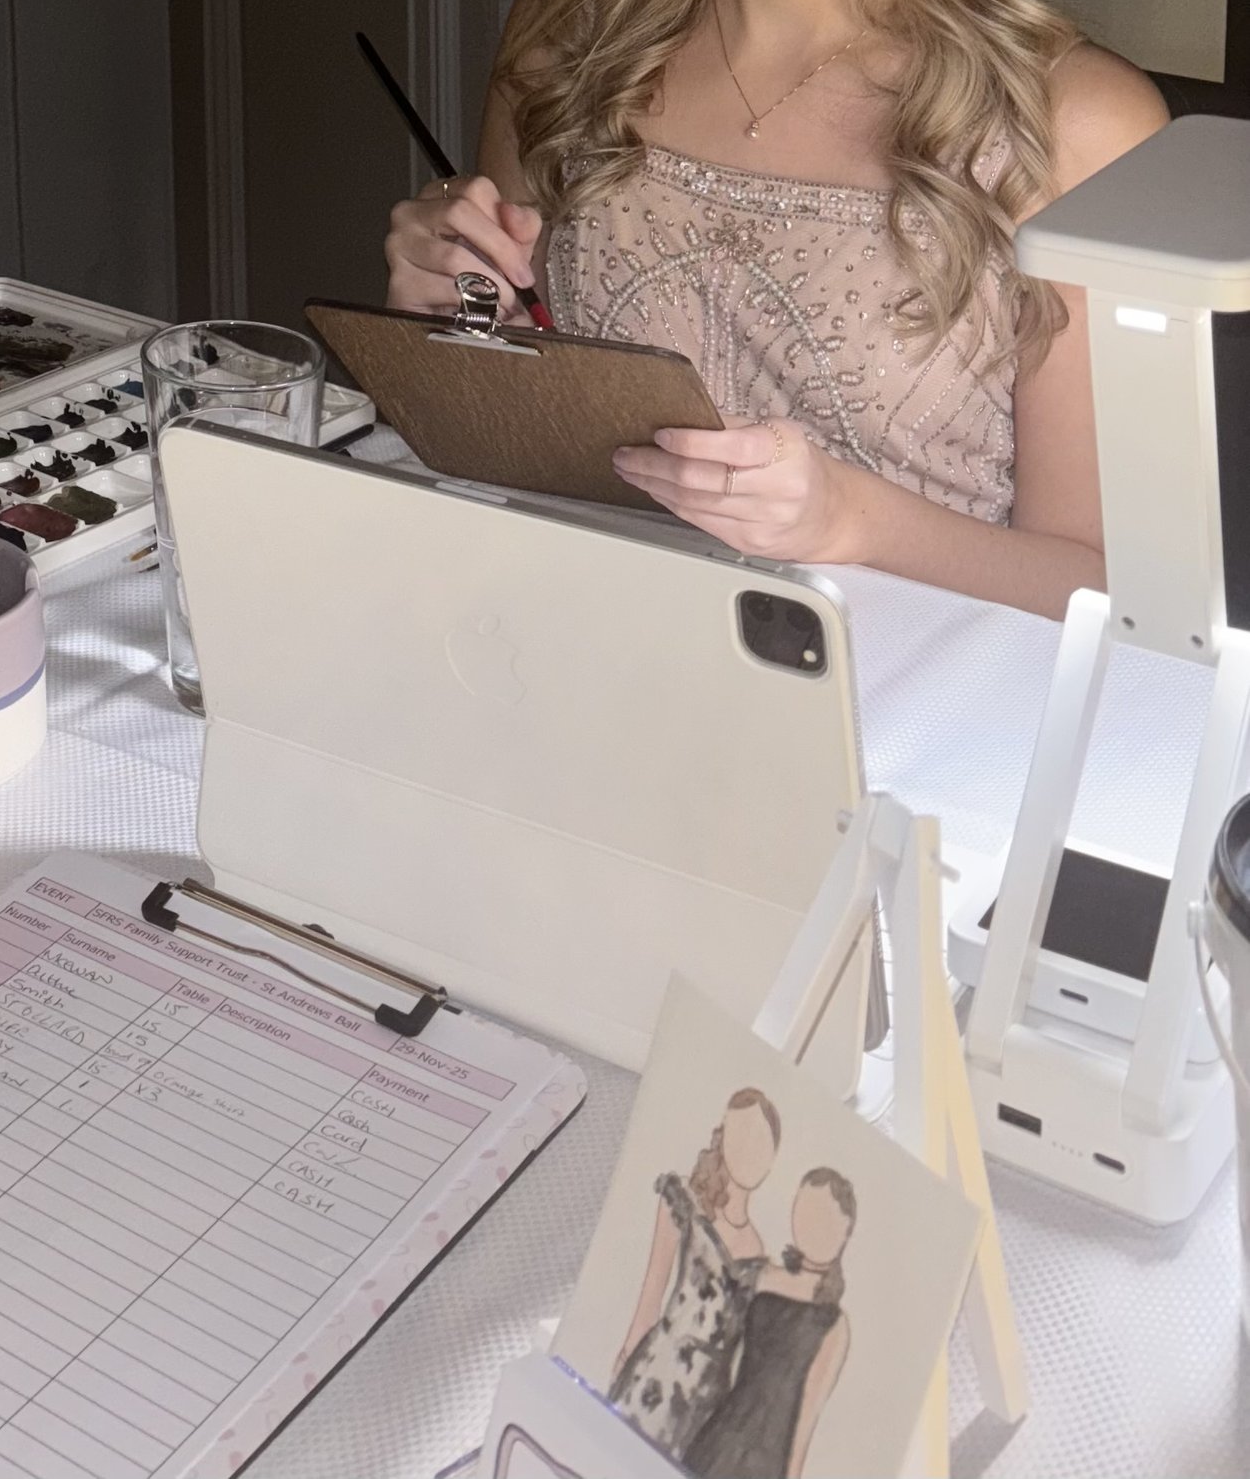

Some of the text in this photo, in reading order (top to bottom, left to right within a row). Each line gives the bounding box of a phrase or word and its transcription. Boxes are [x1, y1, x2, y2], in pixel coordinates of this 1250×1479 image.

[33, 881, 76, 904] EVENT
[4, 905, 52, 932] Number
[63, 931, 117, 962] Surname
[92, 908, 122, 927] SFRS
[123, 922, 165, 945] Family
[164, 940, 214, 968] Support
[216, 961, 249, 983] Trust
[259, 982, 277, 995] St
[277, 990, 333, 1021] Andrews
[334, 1015, 362, 1032] Ball
[9, 978, 64, 1009] Smith
[176, 982, 211, 1005] Table
[219, 1003, 292, 1041] Description
[395, 1041, 470, 1080] 29-Nov-25
[368, 1070, 431, 1103] Payment
[320, 1124, 368, 1152] Card
